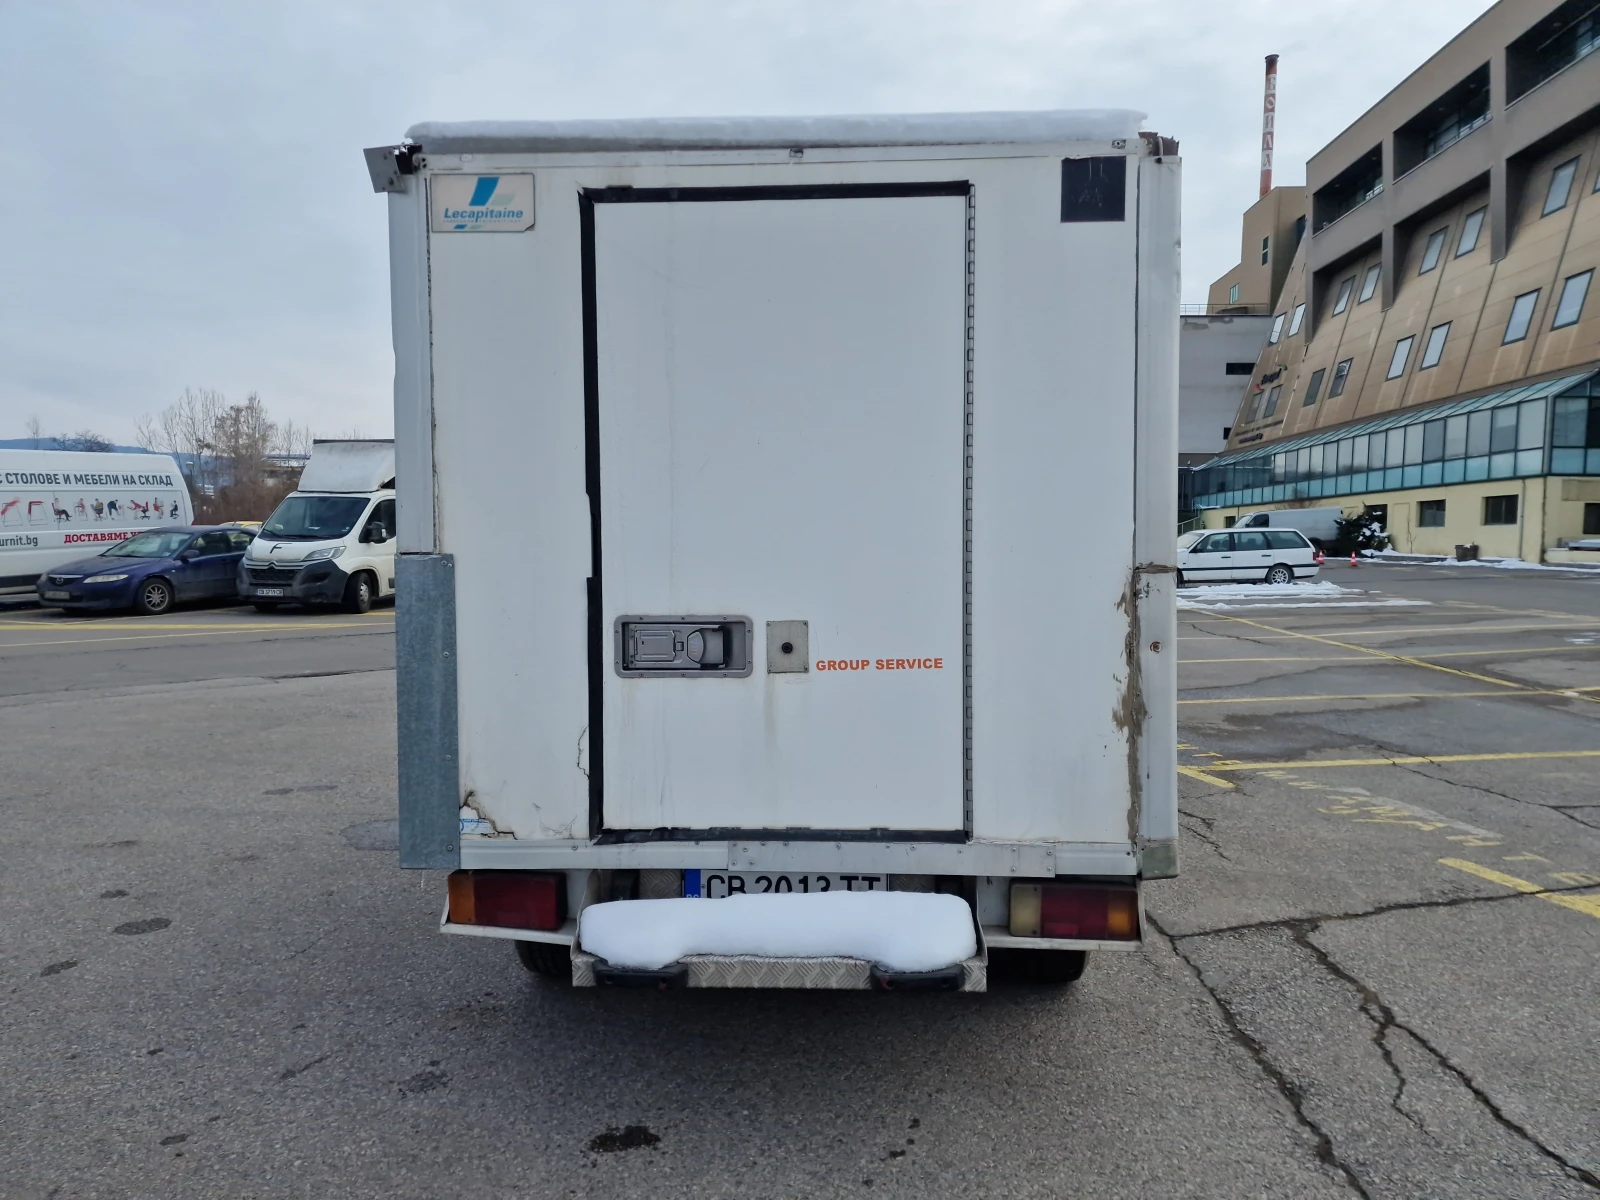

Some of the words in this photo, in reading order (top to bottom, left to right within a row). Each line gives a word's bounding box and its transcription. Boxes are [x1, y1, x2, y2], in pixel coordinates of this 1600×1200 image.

[444, 207, 524, 222] Lecapitaine
[5, 472, 61, 484] СТОЛОВЕ
[63, 474, 71, 484] И
[74, 474, 120, 485] МЕБЕЛИ
[122, 474, 137, 485] НА
[138, 474, 174, 487] СКЛАД
[0, 535, 38, 547] urnit.bg
[64, 532, 129, 544] ДОСТАВЯМЕ
[816, 660, 870, 671] GROUP
[875, 658, 943, 670] SERVICE
